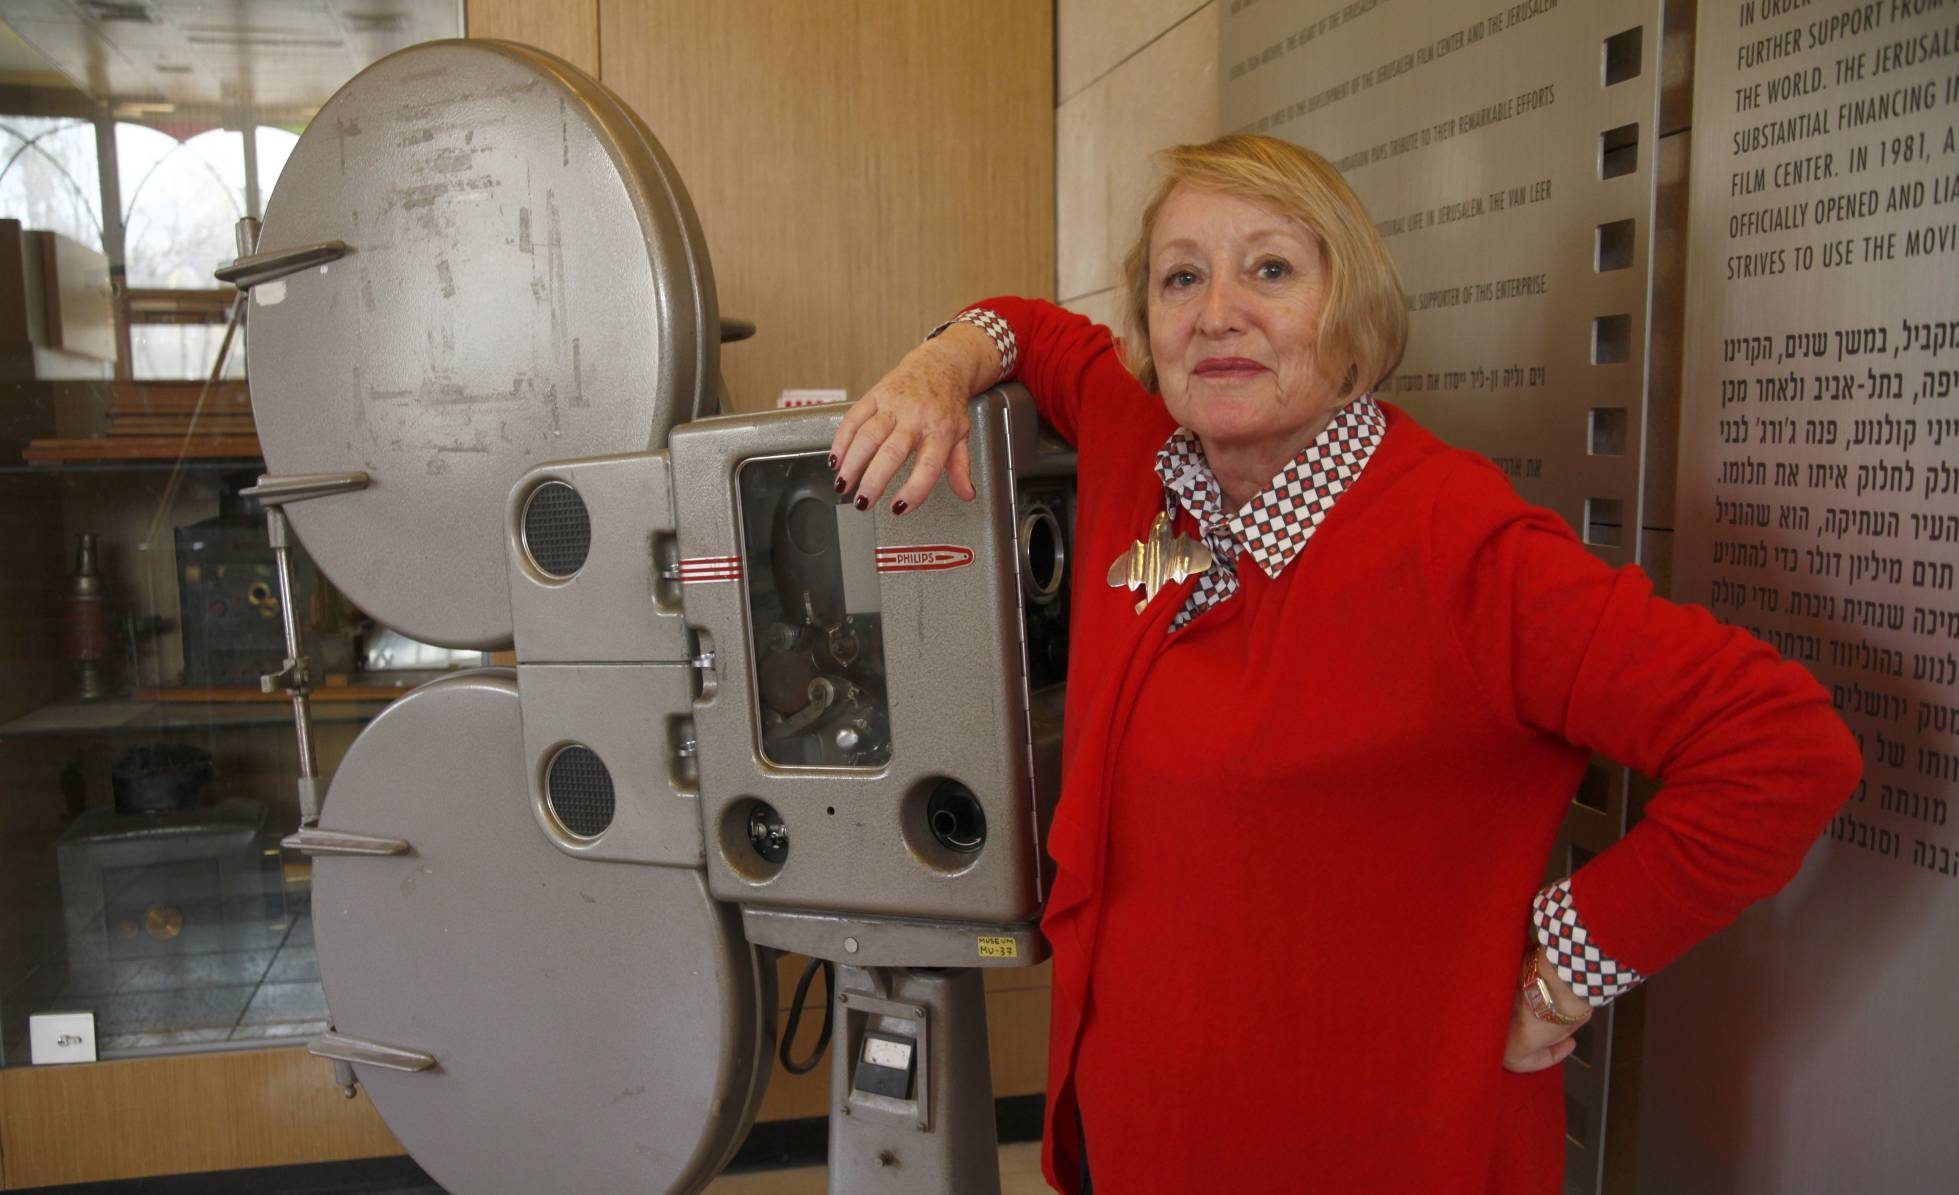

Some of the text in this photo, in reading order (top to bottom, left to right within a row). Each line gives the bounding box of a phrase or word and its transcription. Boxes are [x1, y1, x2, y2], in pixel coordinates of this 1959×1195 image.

[1740, 0, 1755, 28] IN
[1436, 30, 1464, 58] CENTER
[1466, 20, 1485, 45] AND
[1487, 12, 1504, 37] THE
[1738, 28, 1802, 71] FURTHER
[1809, 0, 1885, 50] SUPPORT
[1736, 83, 1762, 112] THE
[1767, 67, 1827, 104] WORLD.
[1835, 52, 1866, 86] THE
[1433, 118, 1456, 144] THEIR
[1457, 98, 1515, 136] REMARKABLE
[1516, 83, 1555, 117] EFFORTS
[1733, 109, 1830, 156] SUBSTANTIAL
[1838, 81, 1936, 131] FINANCING
[1732, 168, 1765, 197] FILM
[1774, 153, 1838, 188] CENTER.
[1849, 145, 1868, 174] IN
[1880, 132, 1930, 167] 1981,
[1488, 190, 1505, 213] THE
[1507, 183, 1527, 209] VAN
[1528, 179, 1552, 204] LEER
[1730, 202, 1808, 239] OFFICIALLY
[1815, 189, 1879, 225] OPENED
[1886, 180, 1925, 213] AND
[1728, 224, 1957, 280] STRIVES TO USE THE MOVI
[1462, 285, 1474, 305] OF
[1475, 282, 1494, 303] THIS
[1724, 336, 1773, 367] הקרינו
[1778, 332, 1828, 365] שנים,
[1834, 327, 1887, 362] במשך
[1721, 379, 1748, 409] מכן
[1755, 371, 1805, 402] ולאחר
[1813, 367, 1903, 401] בתל-אביב
[1720, 414, 1749, 444] לבני
[1755, 416, 1796, 445] ג'ורג'
[1805, 419, 1837, 445] פנה
[1845, 412, 1917, 452] קולנוע,
[1717, 456, 1766, 485] חלומו.
[1774, 462, 1799, 487] את
[1808, 463, 1848, 490] איתו
[1857, 458, 1914, 497] לחלוק
[1715, 495, 1959, 543] העיר העתיקה, הוא שהוביל
[897, 552, 936, 565] PHILIPS
[1774, 546, 1798, 572] כדי
[1806, 544, 1842, 578] דולר
[1849, 549, 1903, 586] מיליון
[1912, 560, 1954, 591] תרם
[1711, 575, 1746, 611] קולק
[1748, 585, 1779, 612] טדי
[1785, 591, 1835, 621] ניכרת.
[1842, 598, 1904, 631] שנתית
[1829, 638, 1903, 677] בהוליווד
[1912, 651, 1957, 686] לנוע
[1834, 681, 1908, 723] ירושלים
[1880, 784, 1947, 826] מונתה
[979, 936, 1014, 945] MUSEUM
